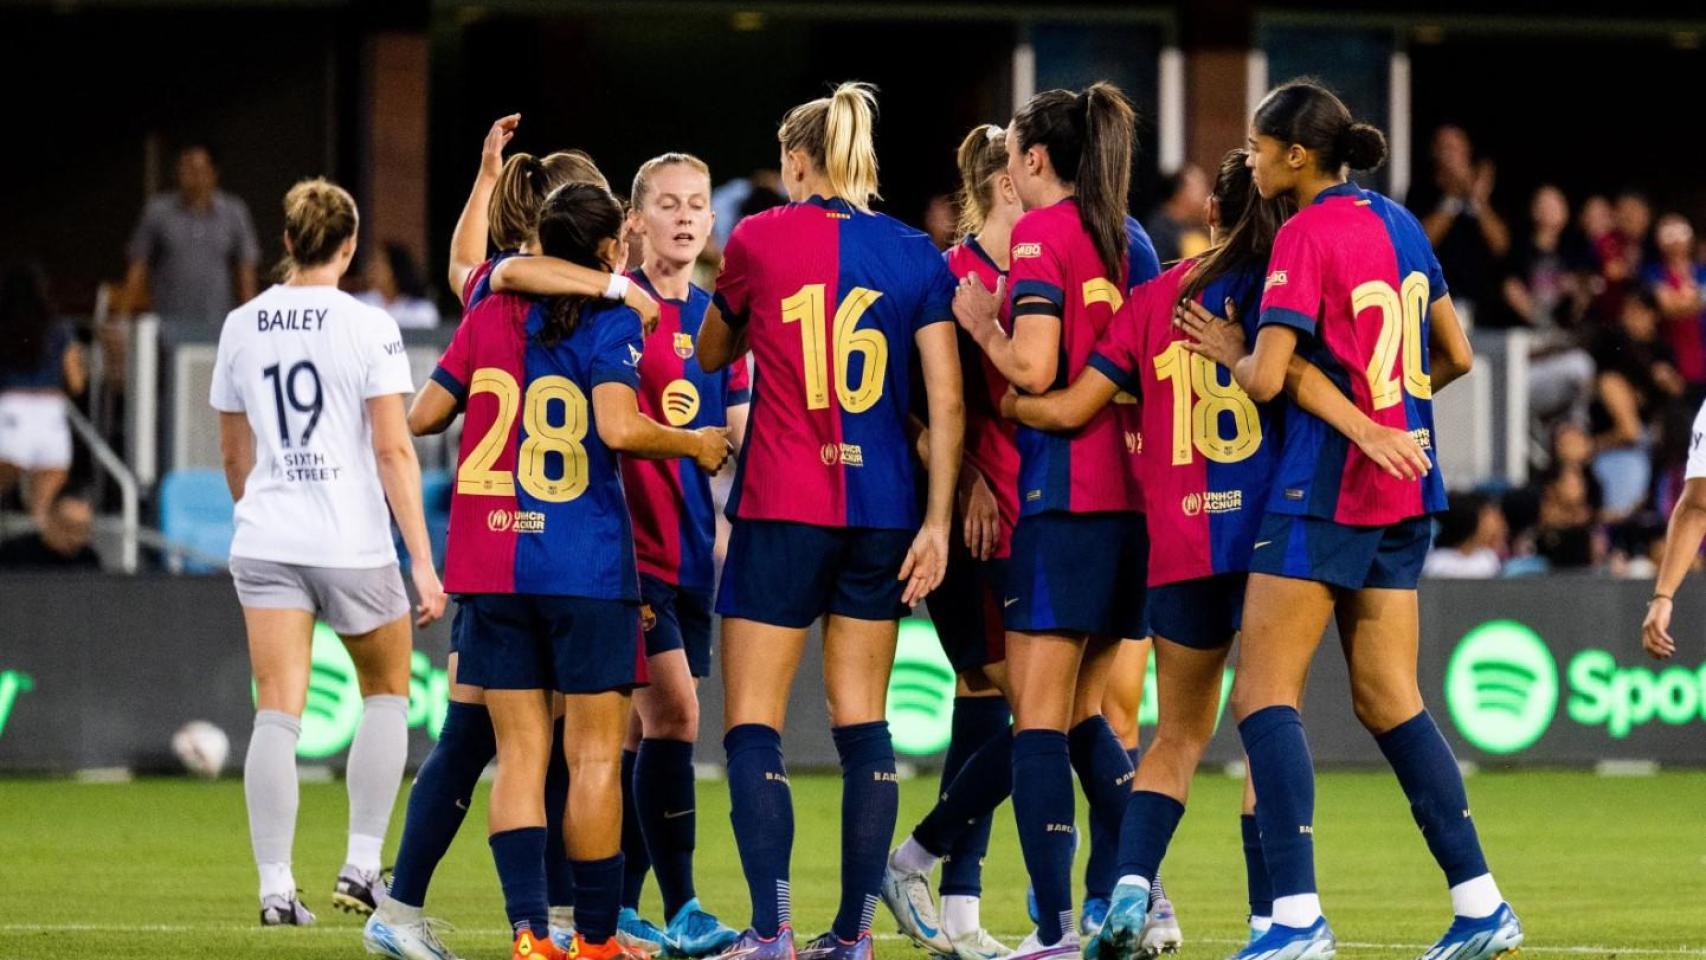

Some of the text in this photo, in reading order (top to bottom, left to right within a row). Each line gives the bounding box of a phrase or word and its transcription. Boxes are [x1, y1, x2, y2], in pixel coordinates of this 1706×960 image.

[257, 308, 328, 332] BAILEY
[780, 283, 888, 413] 16
[1351, 271, 1432, 410] 20
[263, 361, 323, 448] 19
[1152, 339, 1263, 465] 18
[456, 367, 589, 503] 28
[284, 453, 324, 467] SIXTH
[287, 468, 340, 482] STREET
[1203, 490, 1242, 501] UNHCR
[1203, 499, 1242, 510] ACNUR
[513, 510, 546, 521] UNHCR
[512, 520, 546, 531] ACNUR
